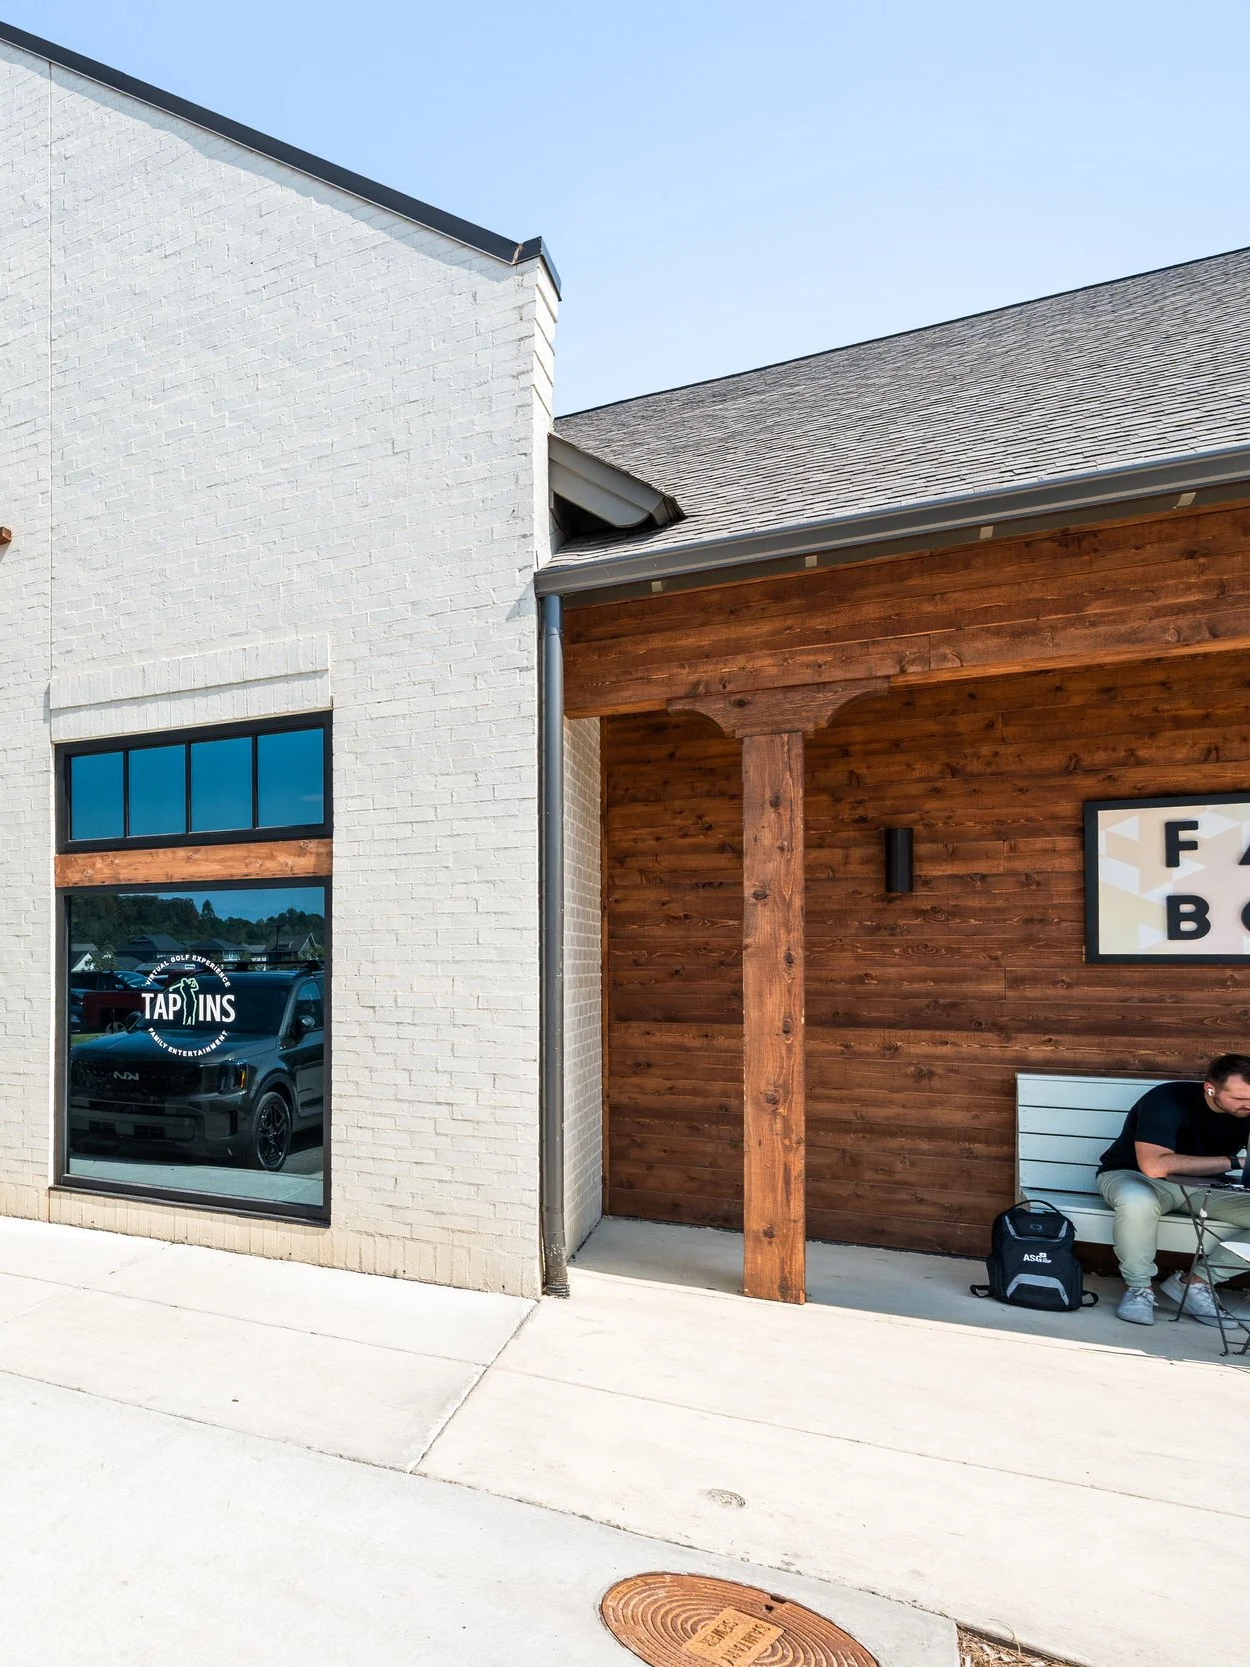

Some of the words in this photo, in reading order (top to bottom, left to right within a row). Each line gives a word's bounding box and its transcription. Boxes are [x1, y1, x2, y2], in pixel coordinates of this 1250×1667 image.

[145, 961, 169, 986] VIRTUAL
[170, 954, 190, 963] GOLF
[192, 954, 231, 988] EXPERIENCE
[141, 993, 182, 1020] TAP
[198, 994, 236, 1023] INS
[148, 1027, 167, 1049] FAMILY
[168, 1030, 228, 1057] ENTERTAINMENT
[1023, 1253, 1042, 1263] ASG
